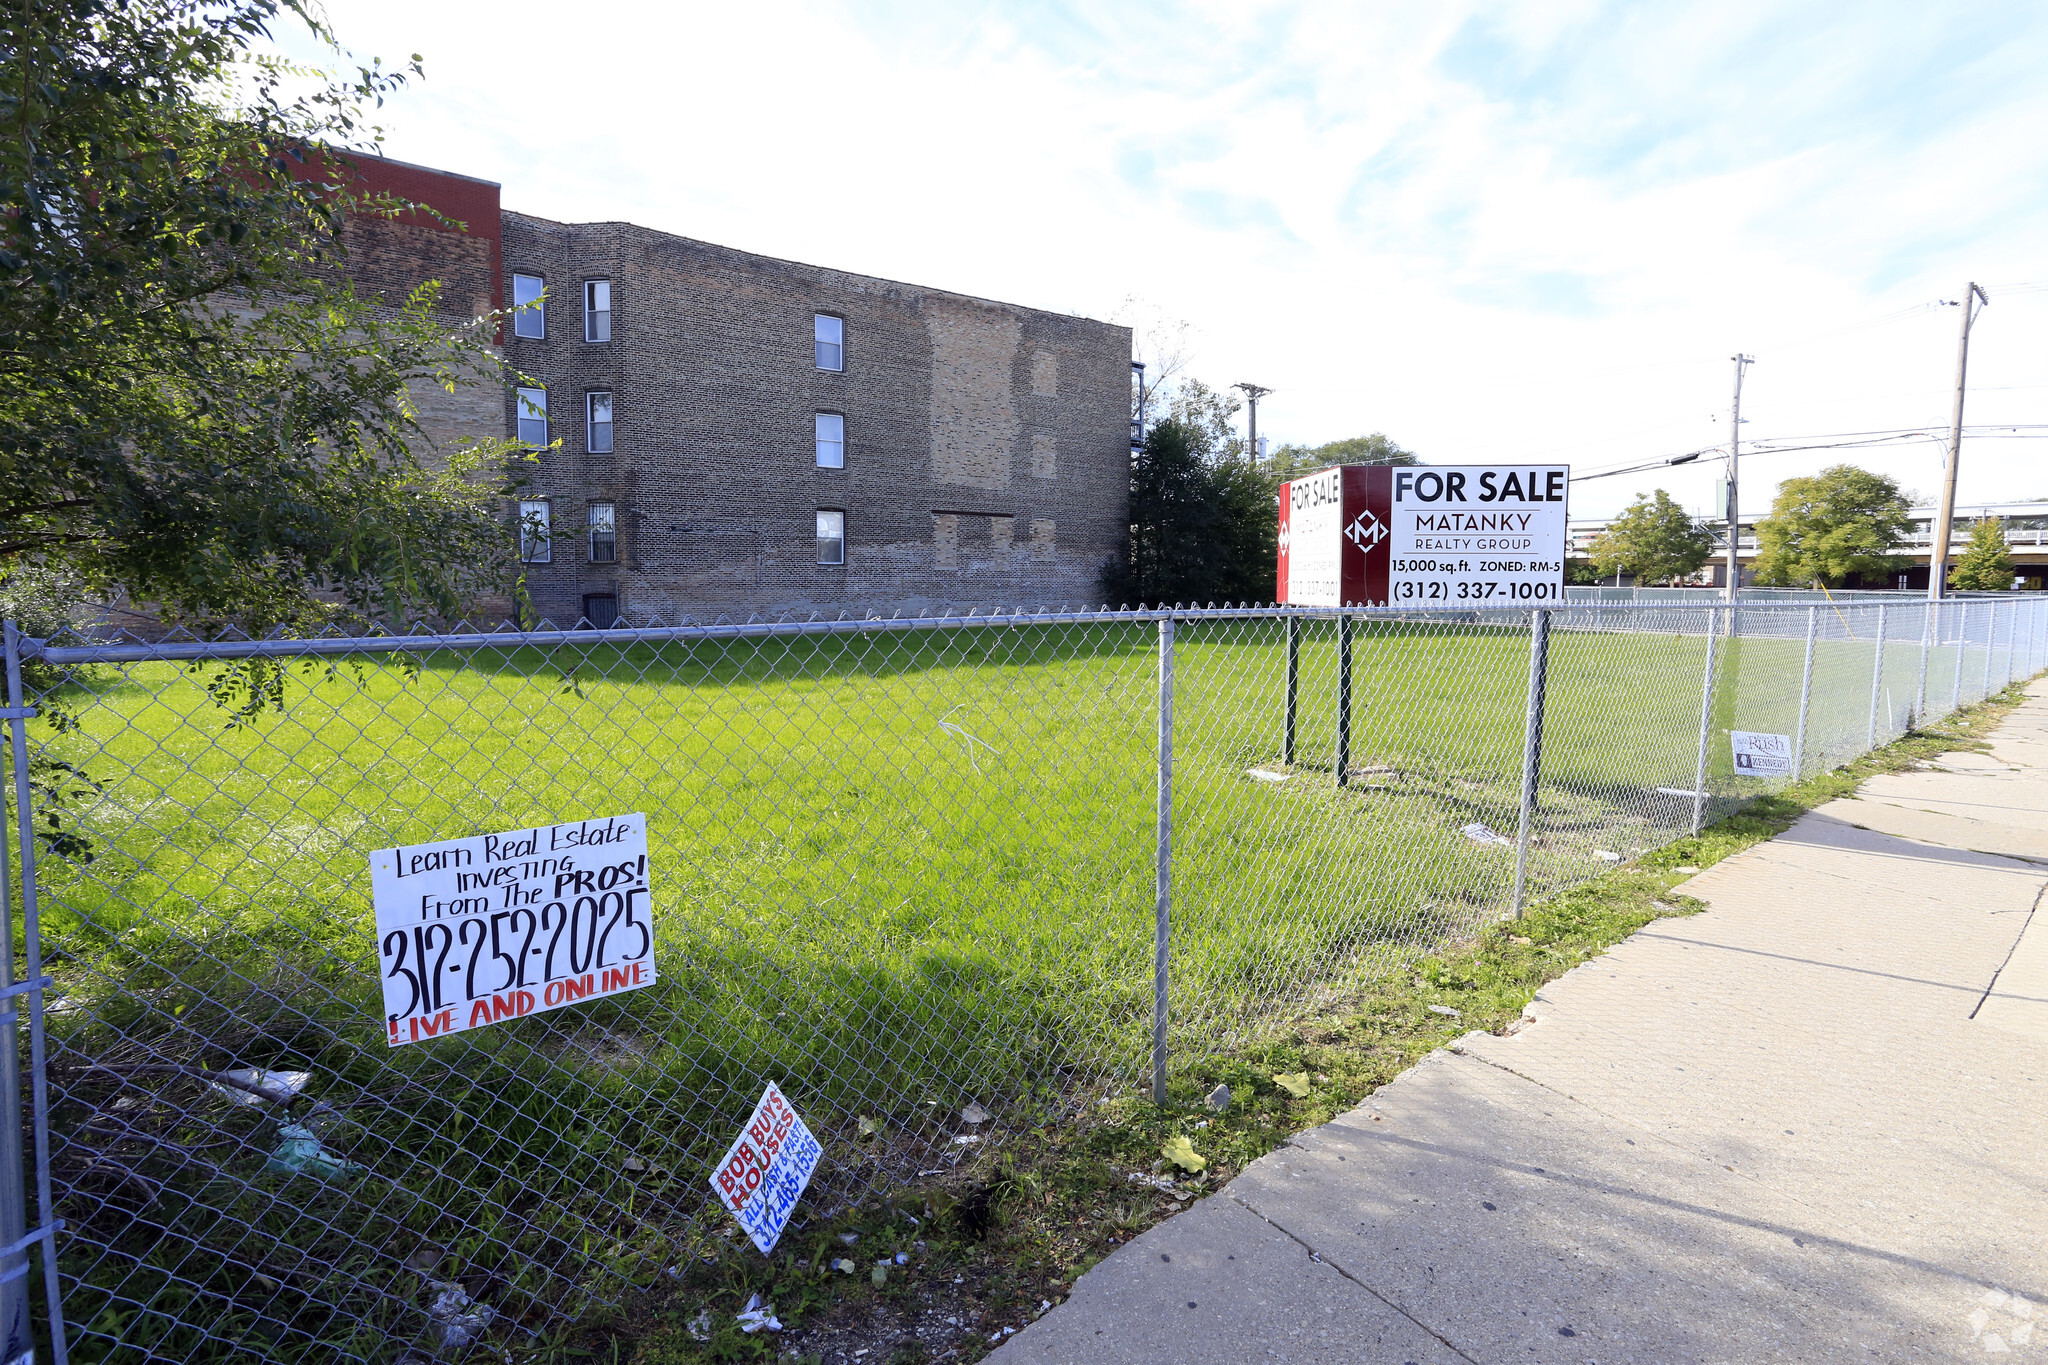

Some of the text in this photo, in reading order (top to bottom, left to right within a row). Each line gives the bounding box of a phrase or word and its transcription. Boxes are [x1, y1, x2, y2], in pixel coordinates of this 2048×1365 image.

[1291, 474, 1338, 511] FOR SALE
[1396, 471, 1564, 502] FOR SALE
[1416, 513, 1532, 531] MATANKY
[1416, 538, 1531, 550] REALTY GROUP
[1392, 560, 1436, 573] 15,000
[1479, 561, 1526, 572] ZONED:
[1530, 561, 1561, 572] RM-5
[1394, 581, 1557, 601] (312) 337-1001
[1749, 735, 1785, 751] Rush
[396, 817, 631, 878] Learn Real Estate
[422, 854, 646, 920] From The PROS!
[383, 887, 650, 1023] 312-252-2025
[389, 961, 649, 1045] LIVE AND ONLINE
[718, 1142, 755, 1195] BOB
[745, 1120, 804, 1227] ALL CASH & FAST!
